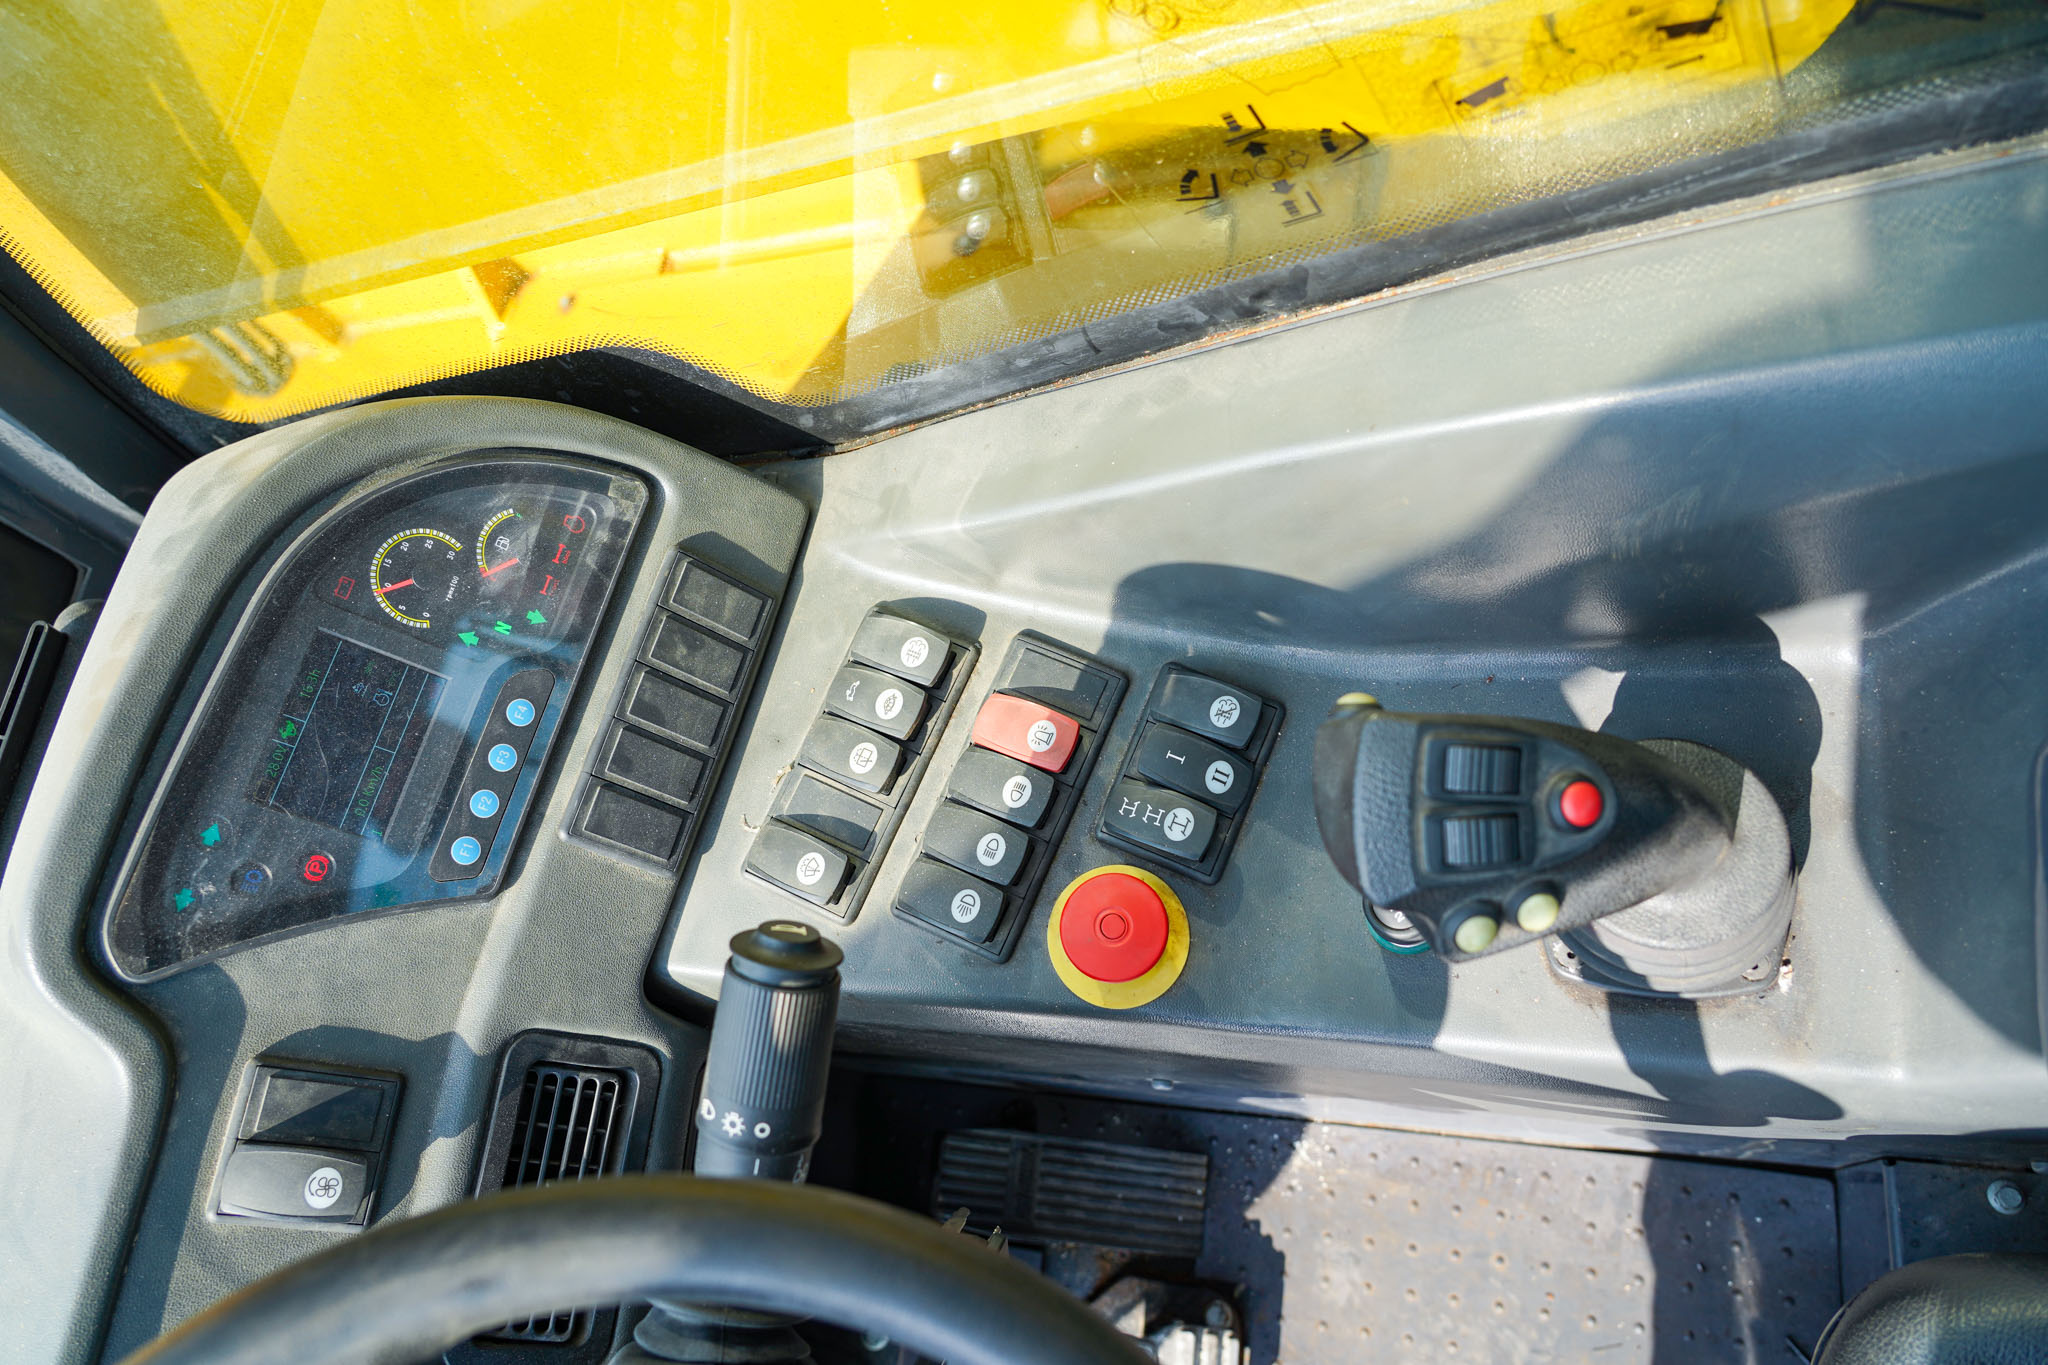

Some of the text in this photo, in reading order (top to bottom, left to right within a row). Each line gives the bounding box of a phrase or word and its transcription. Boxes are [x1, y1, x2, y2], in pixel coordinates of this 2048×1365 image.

[400, 541, 409, 551] 20
[425, 539, 434, 549] 25
[383, 558, 392, 567] 15
[446, 550, 456, 560] 30
[494, 620, 512, 636] N
[514, 705, 528, 720] F4
[264, 744, 287, 777] 28.0V
[496, 750, 510, 766] F3
[1212, 768, 1230, 786] II
[354, 798, 369, 816] 0.0
[478, 796, 493, 812] F2
[460, 843, 474, 857] F1
